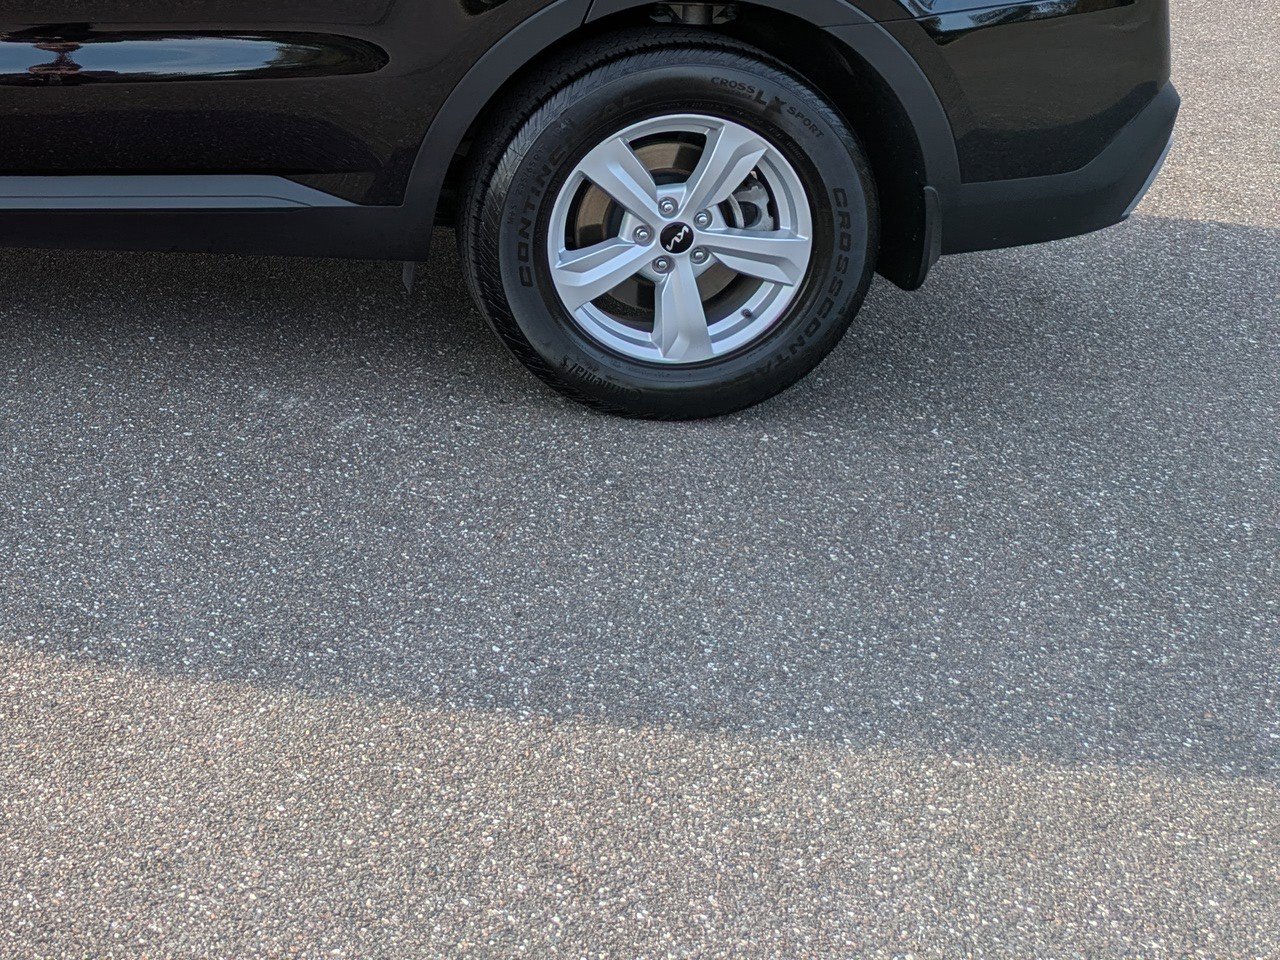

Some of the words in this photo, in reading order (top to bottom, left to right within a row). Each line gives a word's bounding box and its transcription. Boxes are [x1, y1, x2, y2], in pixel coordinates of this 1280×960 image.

[517, 97, 644, 288] CONTINEAL
[710, 76, 756, 94] CROSS
[786, 106, 825, 138] SPORT
[740, 187, 853, 382] CROSSCONTA
